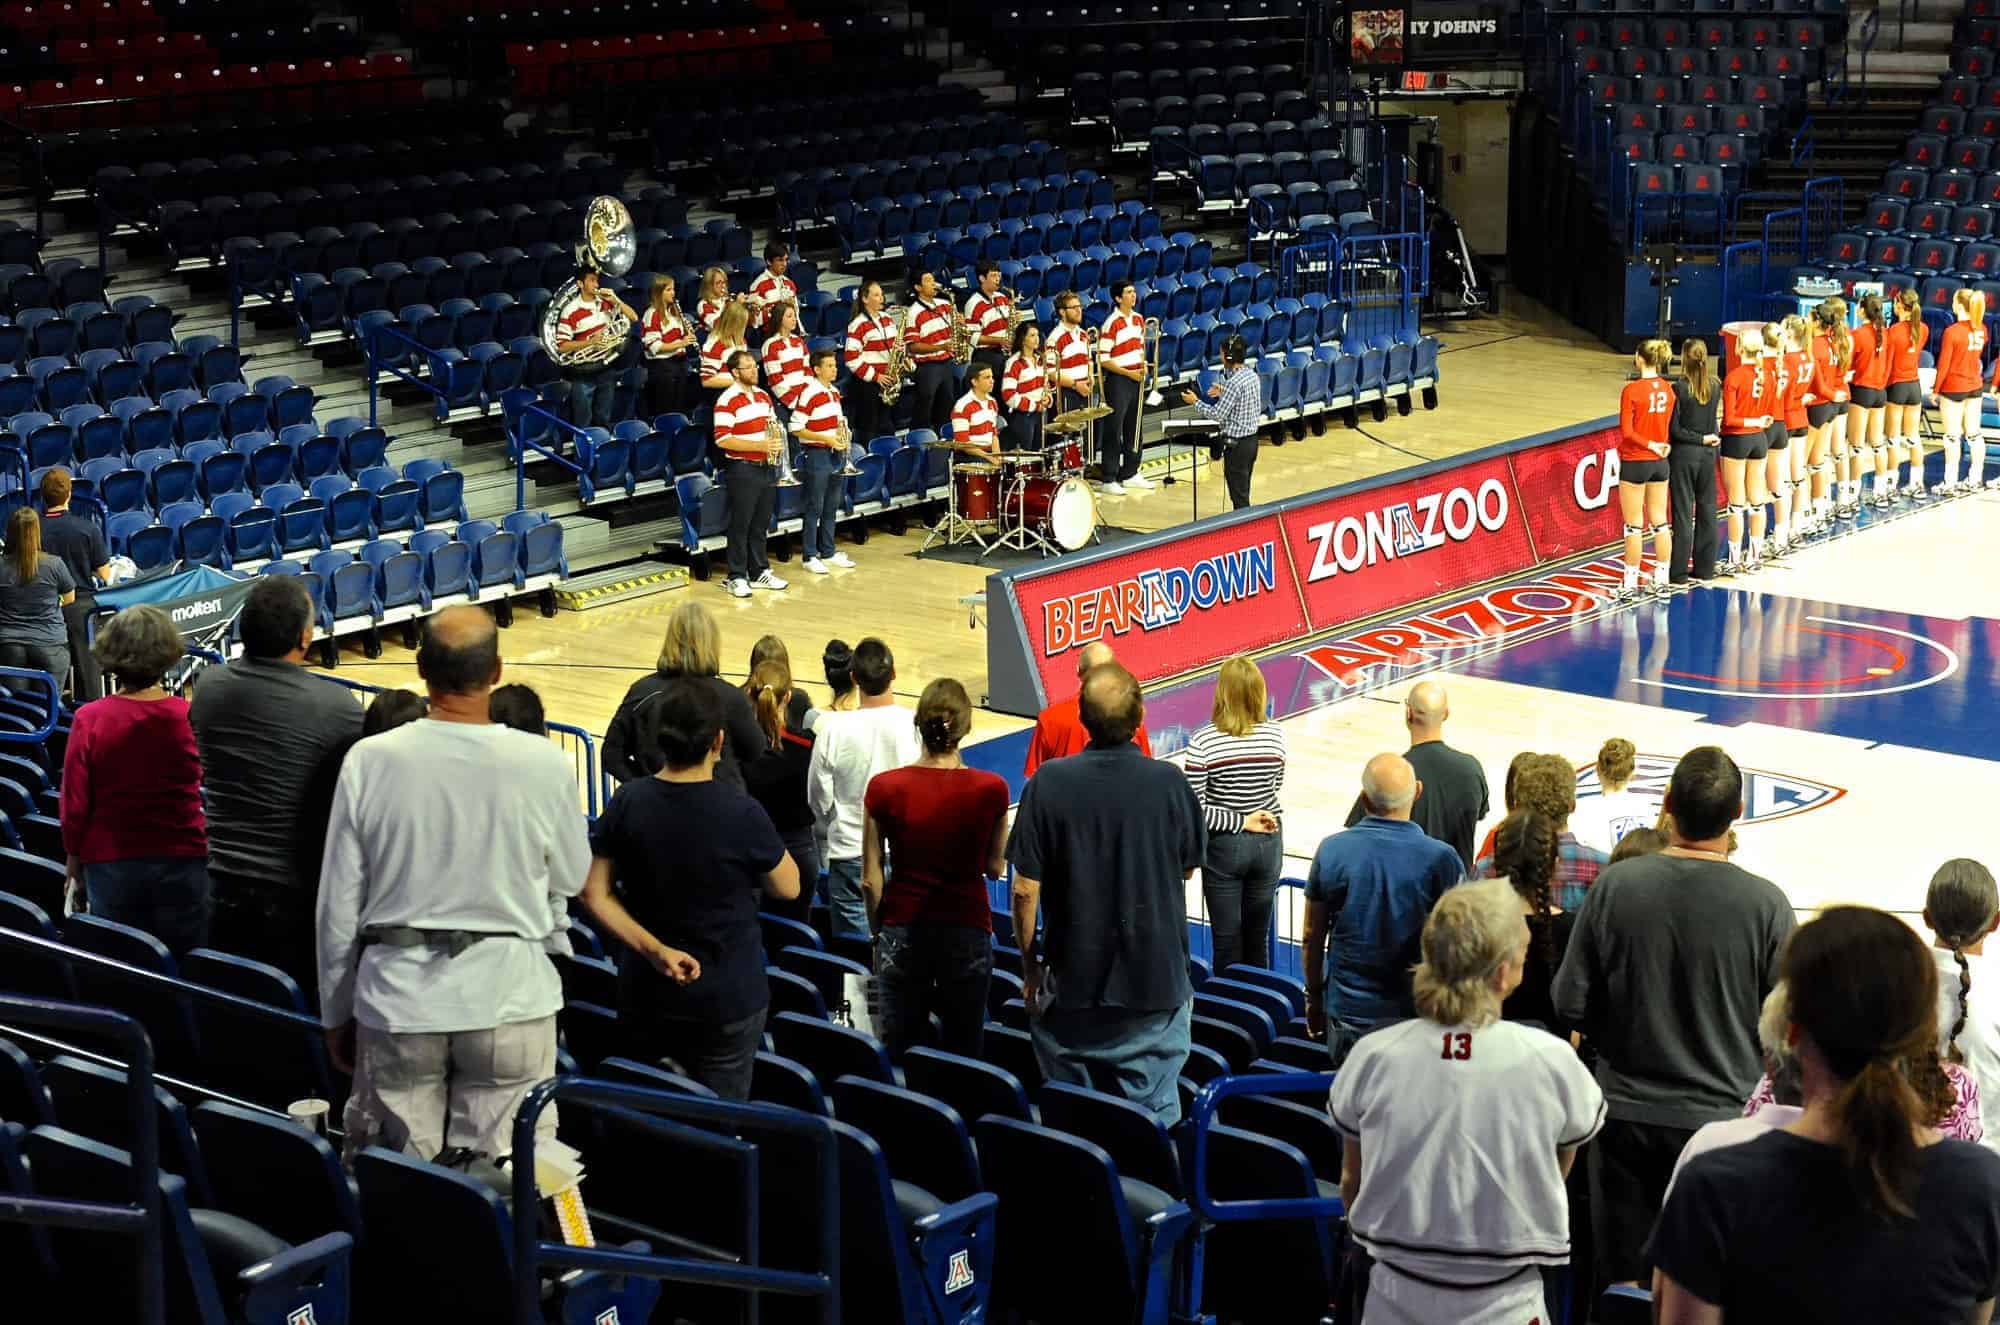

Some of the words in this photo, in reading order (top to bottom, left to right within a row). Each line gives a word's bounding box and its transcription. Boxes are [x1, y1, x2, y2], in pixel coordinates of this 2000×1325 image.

[1433, 20, 1496, 38] JOHN'S
[1967, 330, 1985, 351] 15
[1797, 361, 1815, 384] 17
[1648, 391, 1668, 413] 12
[1307, 479, 1509, 582] ZONAZOO
[171, 598, 222, 622] molten
[1292, 552, 1660, 689] ARIZON
[1441, 1031, 1472, 1060] 13
[945, 1248, 974, 1295] A
